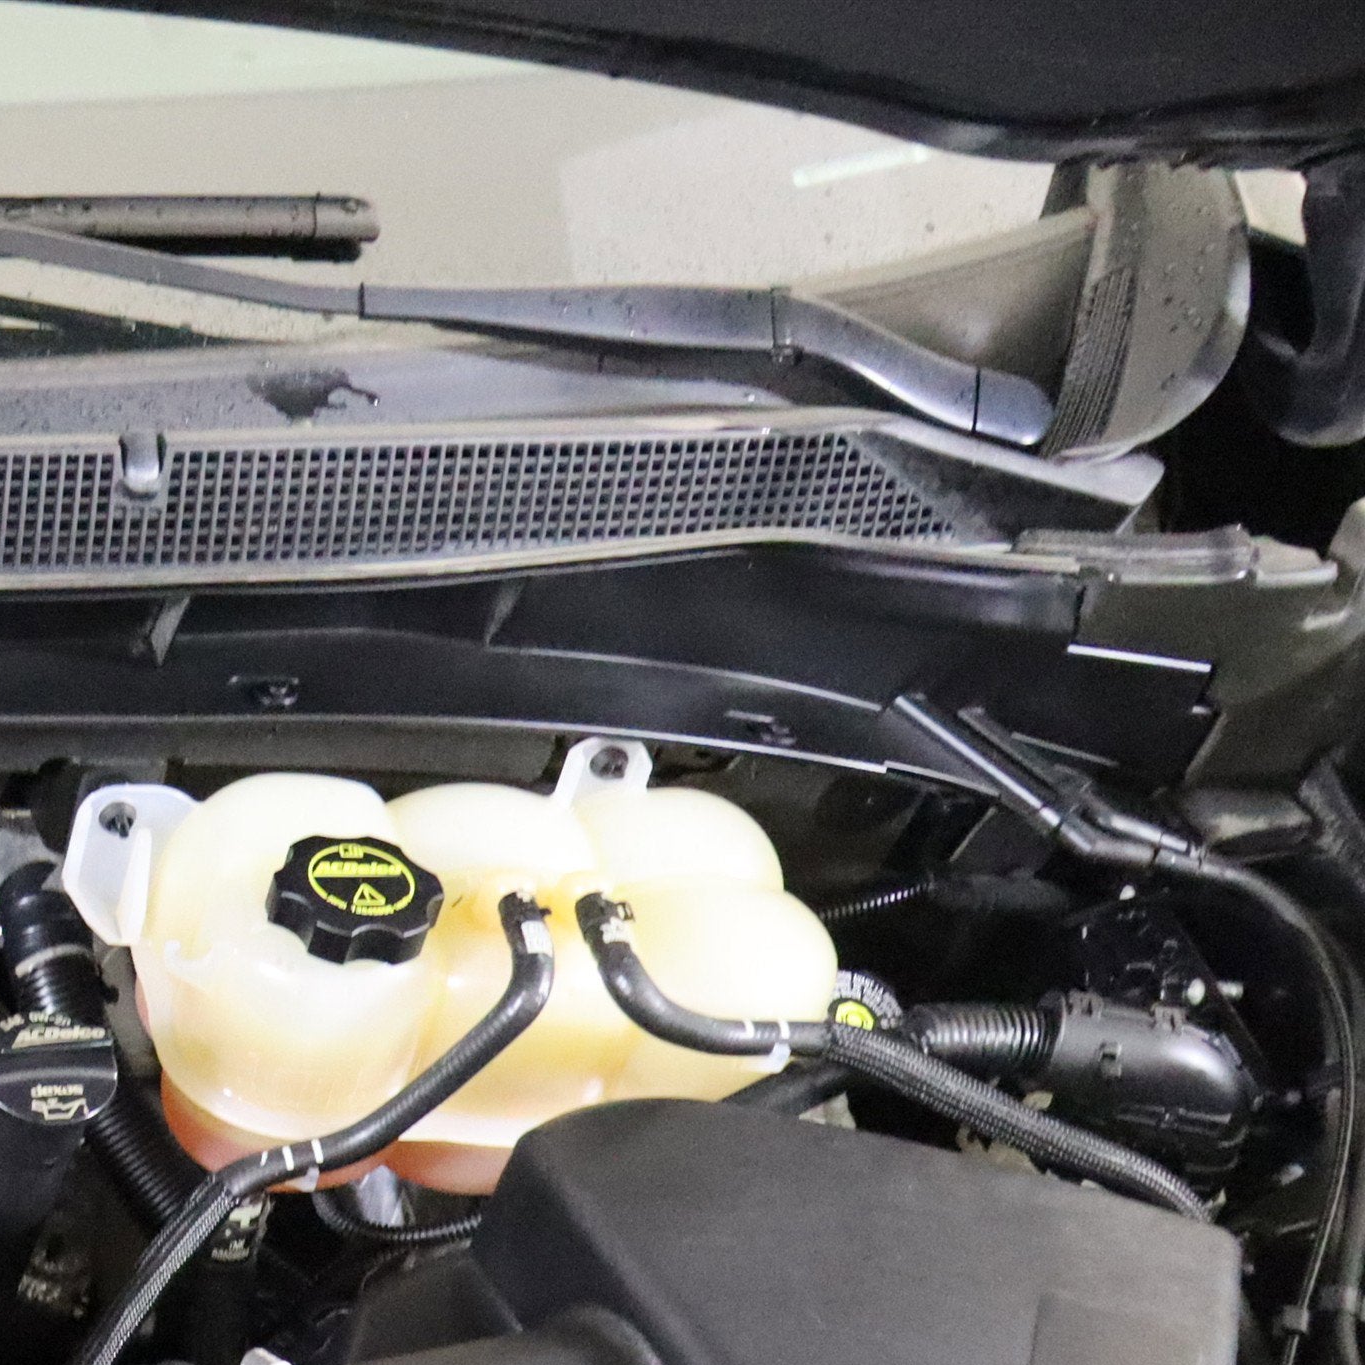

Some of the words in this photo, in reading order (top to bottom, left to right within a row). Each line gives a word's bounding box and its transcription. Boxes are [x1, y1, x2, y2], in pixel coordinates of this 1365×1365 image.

[312, 861, 402, 878] ACDelco
[11, 1024, 106, 1049] ACDelco
[30, 1083, 84, 1099] dexos
